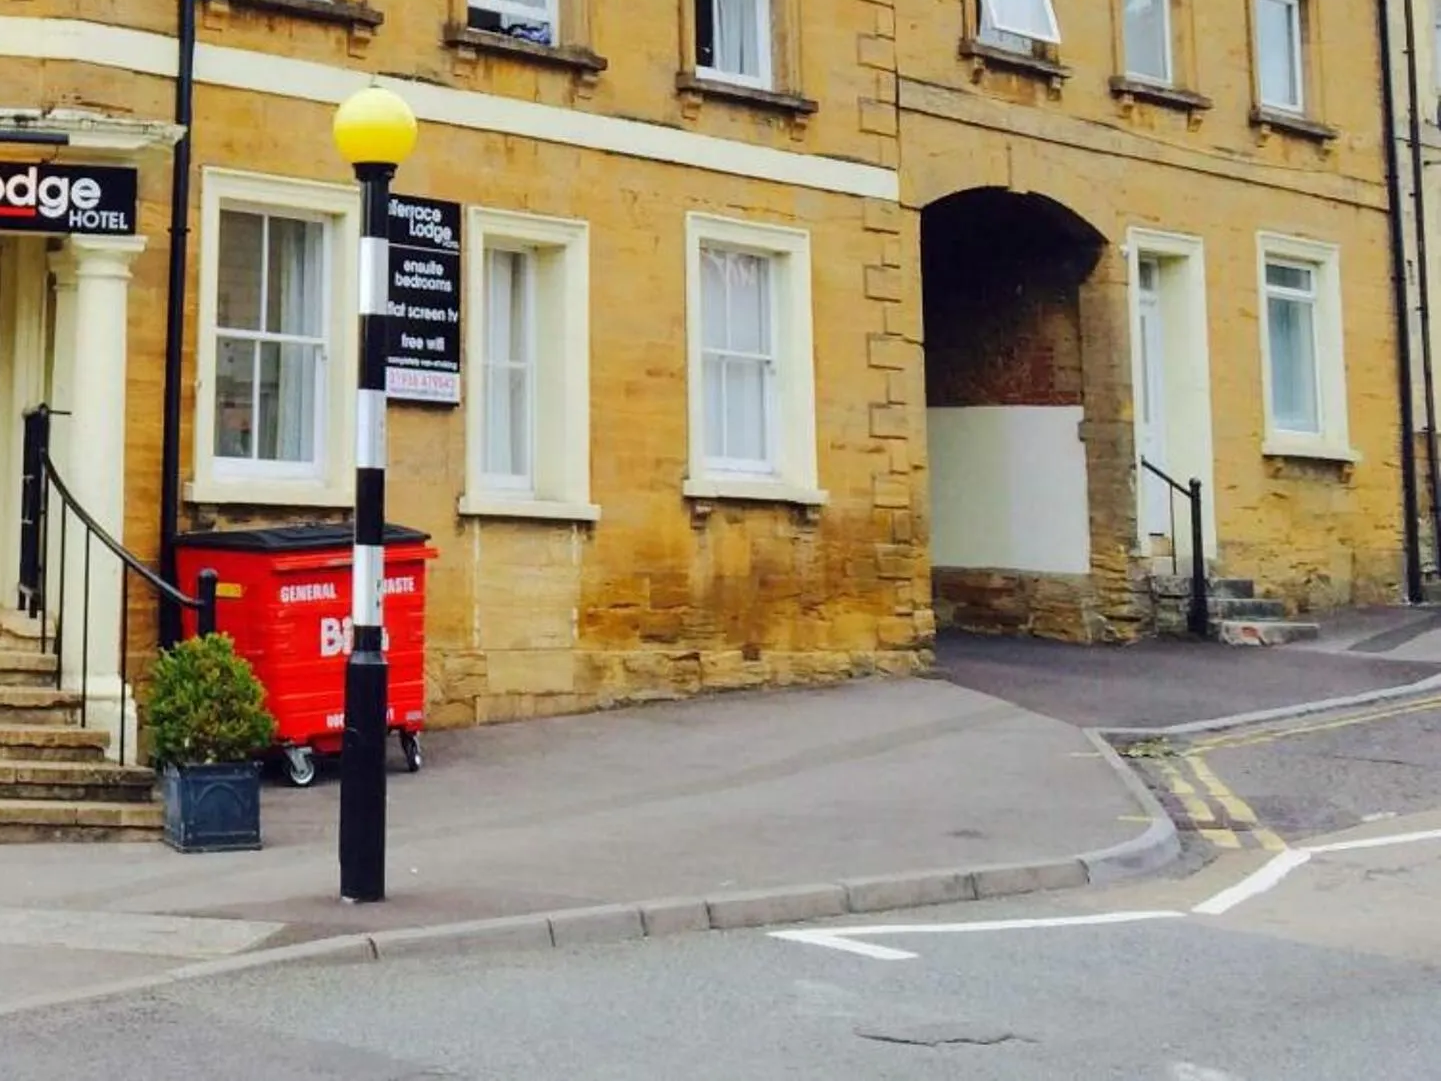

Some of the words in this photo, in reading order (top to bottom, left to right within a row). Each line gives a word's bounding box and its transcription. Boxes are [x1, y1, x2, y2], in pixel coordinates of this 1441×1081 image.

[69, 210, 128, 230] HOTEL
[391, 199, 441, 222] Terrace
[409, 222, 452, 244] Lodge
[403, 260, 444, 276] ensuite
[394, 273, 452, 292] bedrooms
[408, 305, 446, 322] screen
[448, 308, 458, 322] tv
[401, 333, 423, 350] free
[426, 337, 445, 351] wifi
[280, 582, 336, 602] GENERAL
